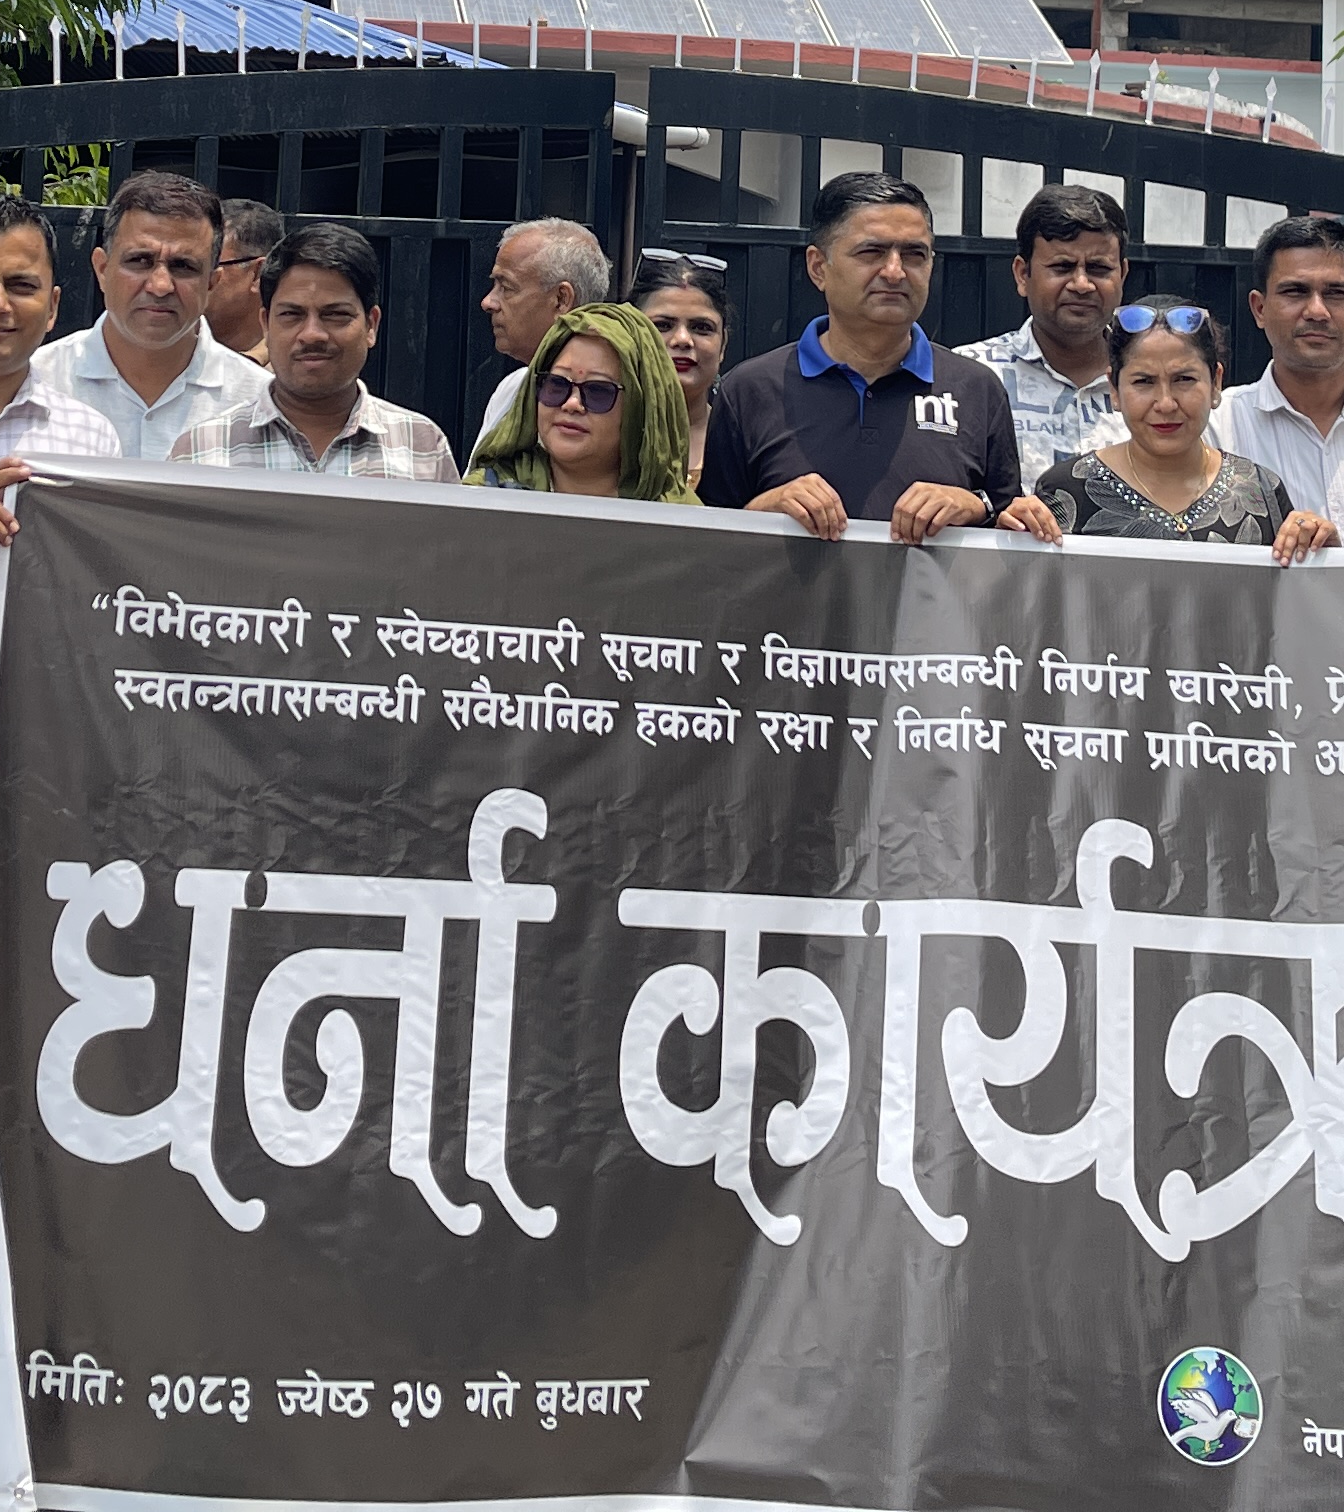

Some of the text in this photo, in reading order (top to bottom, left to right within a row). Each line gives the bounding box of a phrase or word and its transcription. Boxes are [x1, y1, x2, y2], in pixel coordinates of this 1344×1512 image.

[914, 392, 959, 428] nt
[328, 614, 359, 657] र
[376, 609, 584, 671] स्वेच्छाचारी
[601, 634, 702, 681] सूचना
[717, 642, 746, 684] र
[761, 633, 1023, 692] विज्ञापनसम्बन्धी
[1039, 649, 1150, 700] निर्णय
[1166, 663, 1302, 719] खारेजी,
[115, 670, 425, 723] स्वतन्त्रतासम्बन्धी
[635, 698, 741, 746] हकको
[756, 711, 833, 753] रक्षा
[848, 718, 878, 759] र
[1023, 723, 1129, 770] सूचना
[1144, 722, 1296, 774] प्राप्तिको
[37, 789, 557, 1238] धर्ना
[149, 1375, 250, 1422] २०८३
[277, 1370, 374, 1417] ज्येष्ठ
[392, 1382, 441, 1427] २७
[465, 1372, 520, 1419] गते
[536, 1379, 649, 1429] बुधबार
